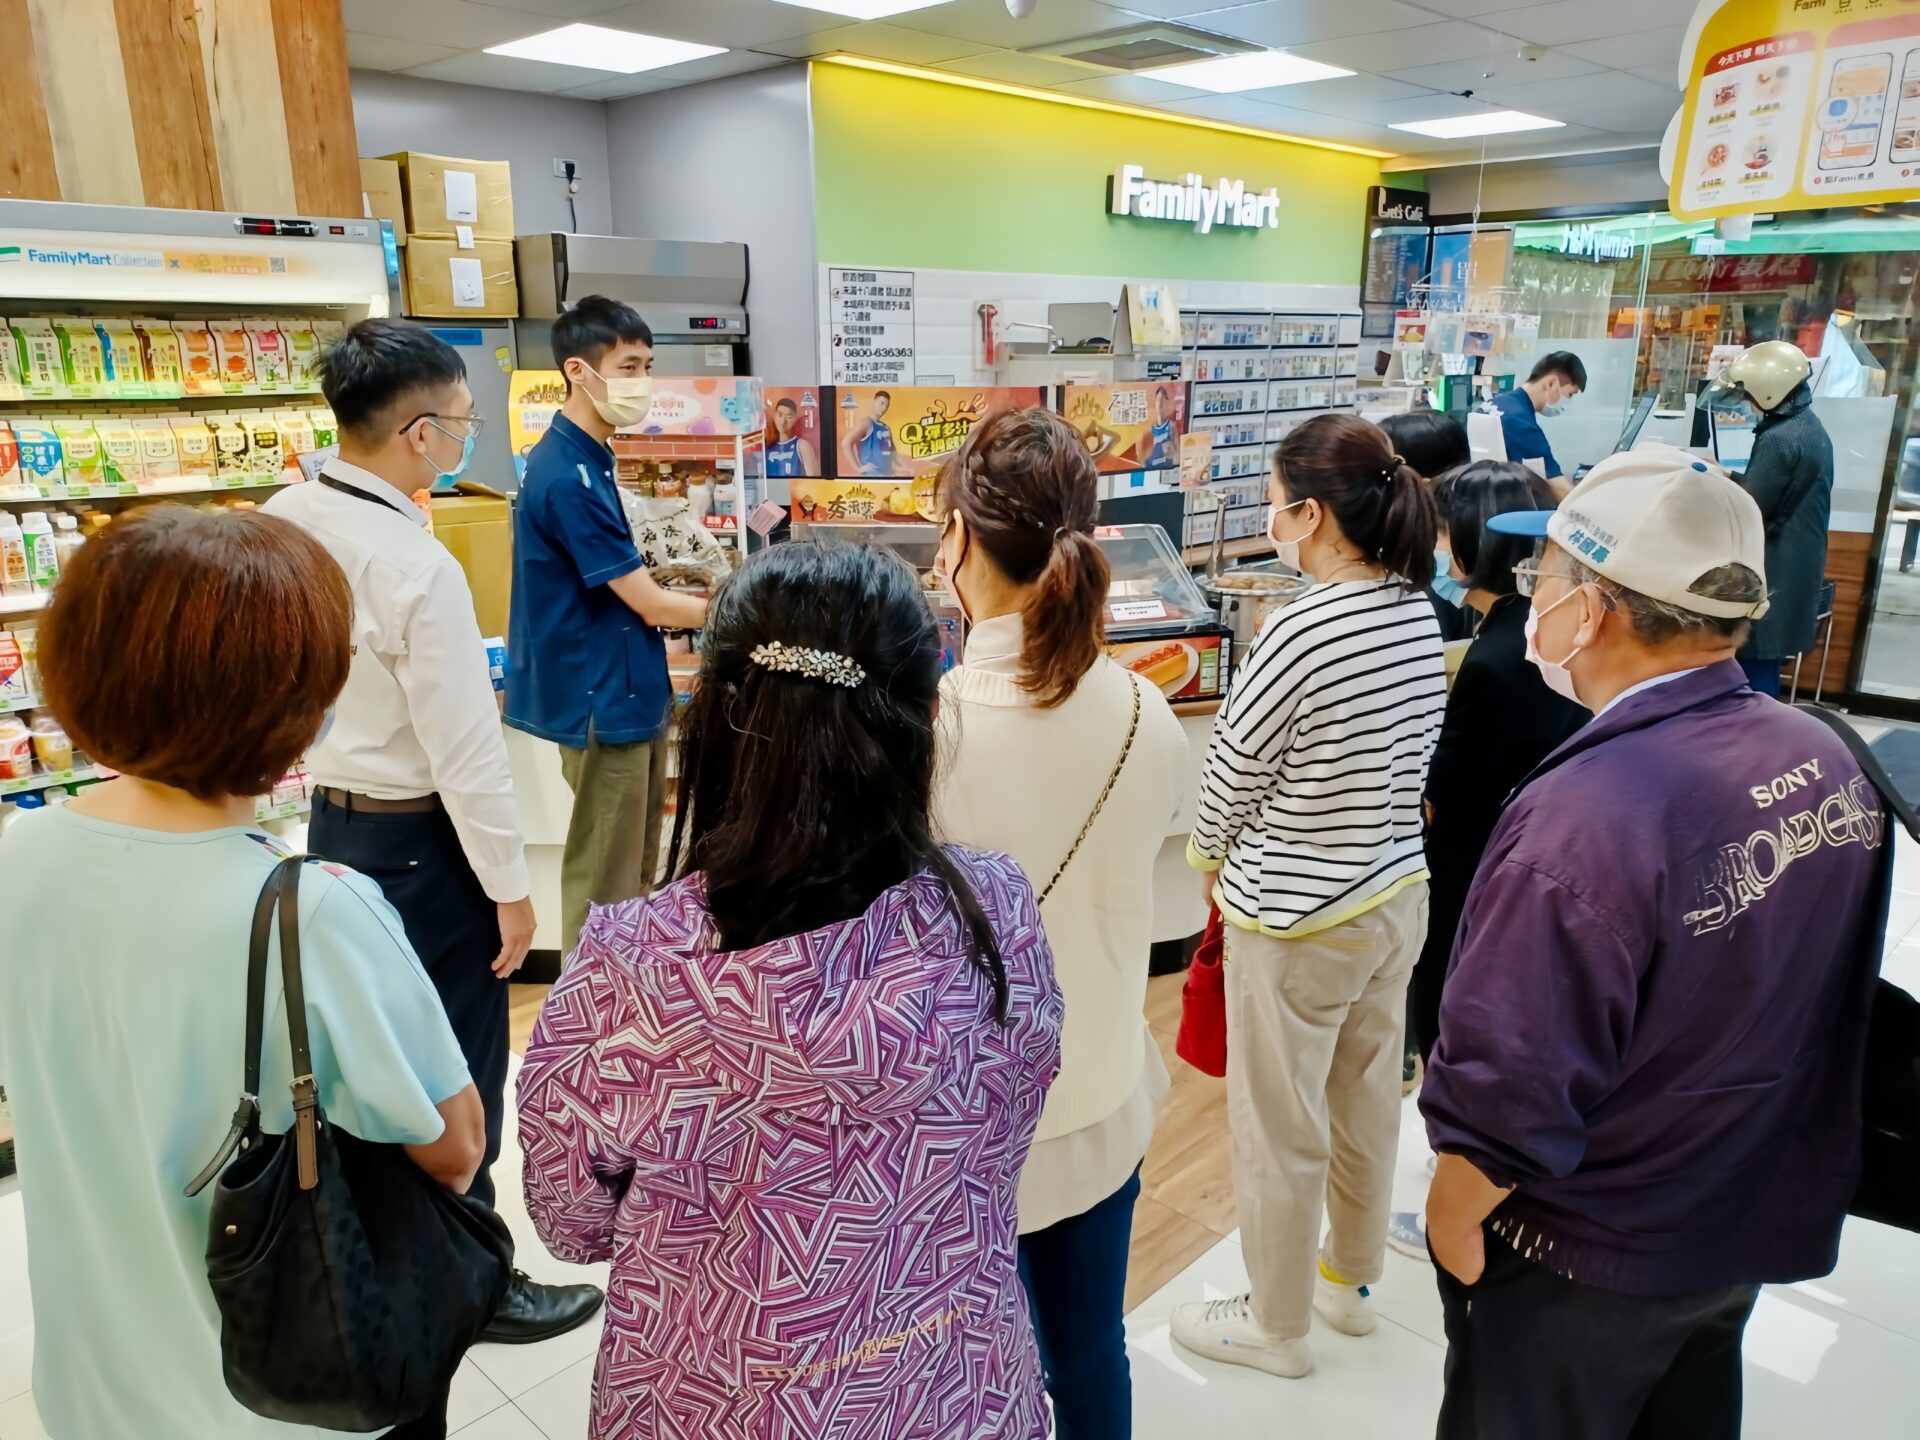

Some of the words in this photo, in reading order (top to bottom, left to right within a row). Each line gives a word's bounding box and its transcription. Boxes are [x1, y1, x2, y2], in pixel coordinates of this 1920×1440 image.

[1111, 164, 1280, 234] FamilyMart
[28, 249, 112, 266] FamilyMart
[1750, 758, 1823, 809] SONY
